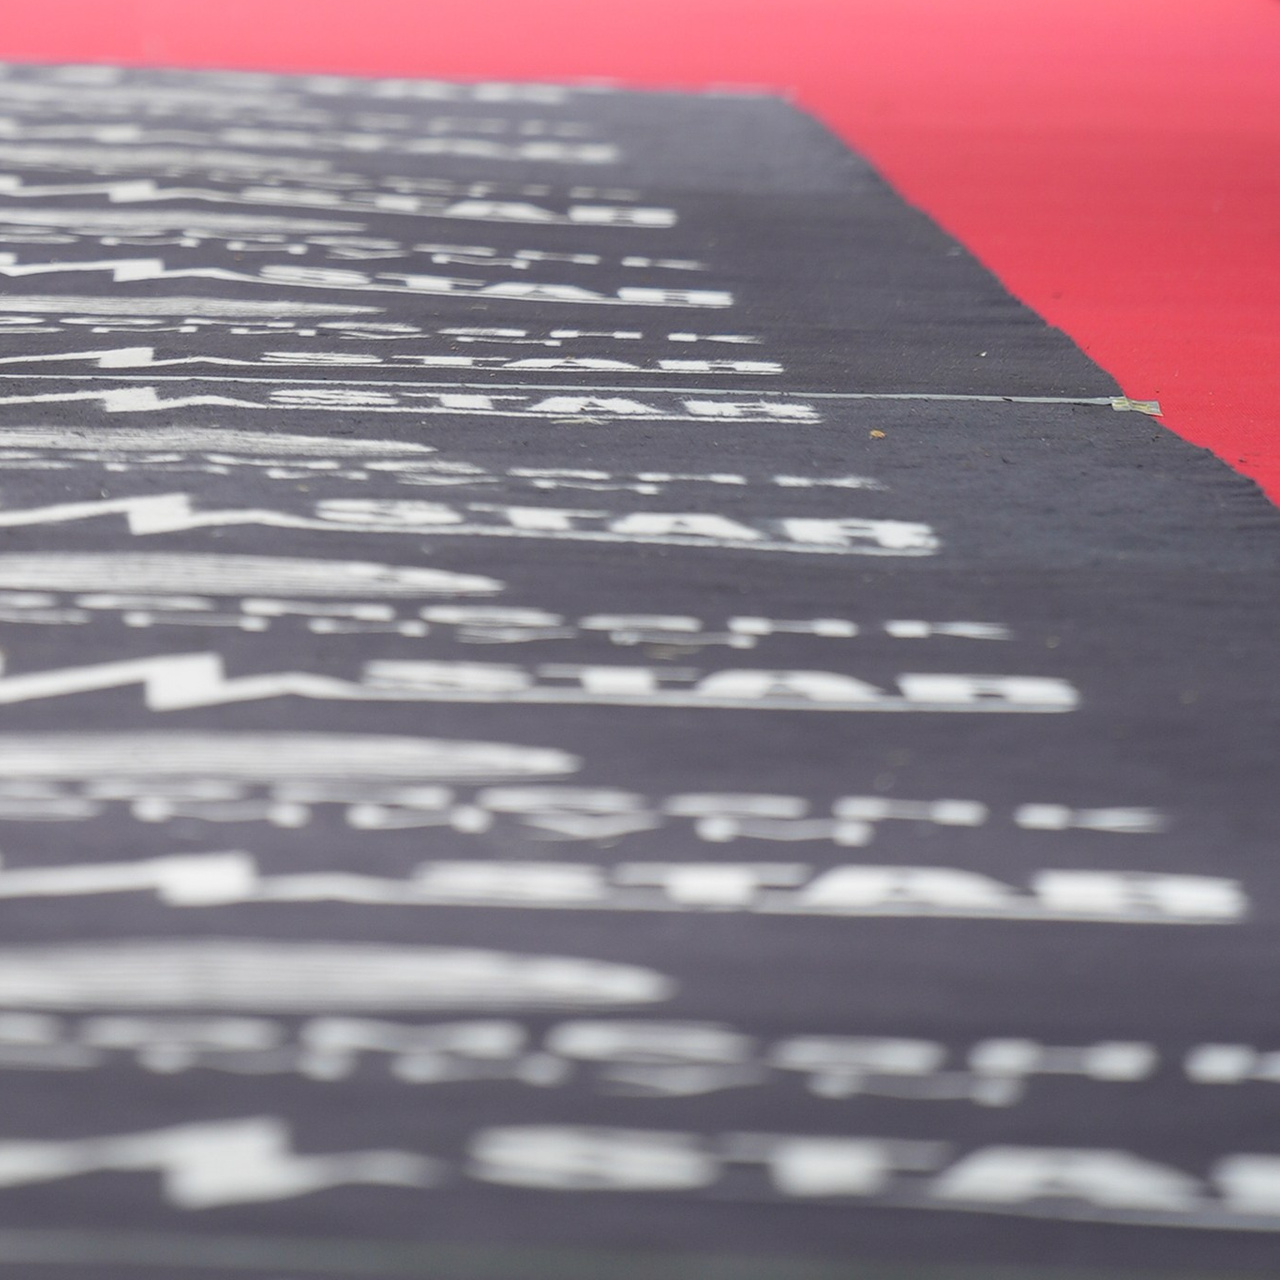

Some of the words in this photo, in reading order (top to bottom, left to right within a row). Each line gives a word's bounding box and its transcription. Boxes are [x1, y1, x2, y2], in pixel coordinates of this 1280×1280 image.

[261, 265, 732, 304] STAR
[263, 352, 783, 370] STAR
[272, 390, 821, 418] STAR
[318, 499, 940, 550] STAR
[364, 659, 1078, 706] STAR
[420, 859, 1240, 914] STAR
[468, 1124, 1280, 1215] STA
